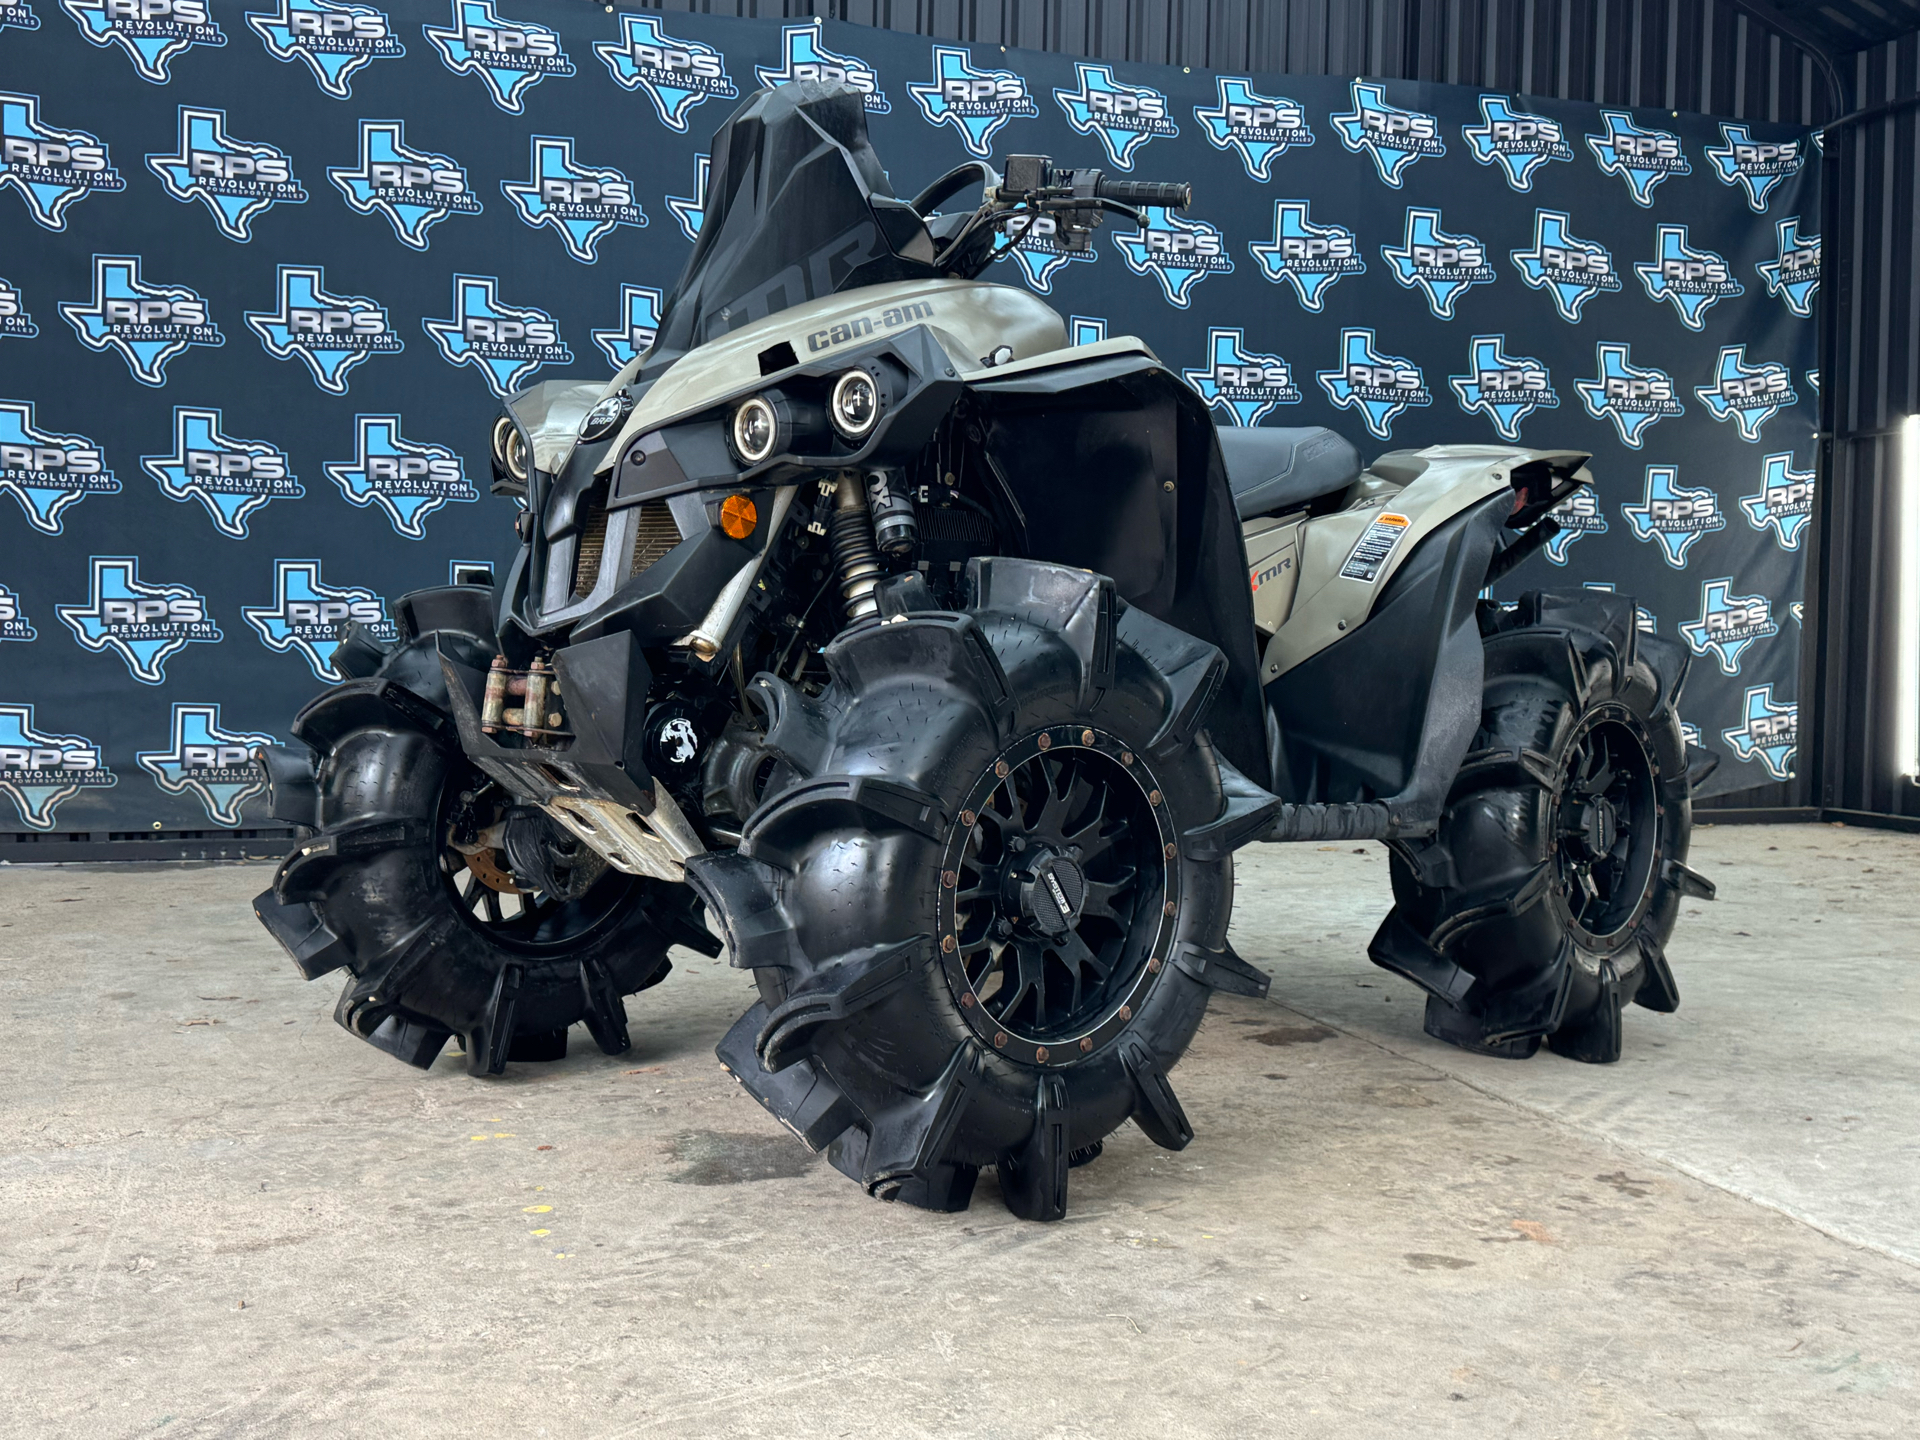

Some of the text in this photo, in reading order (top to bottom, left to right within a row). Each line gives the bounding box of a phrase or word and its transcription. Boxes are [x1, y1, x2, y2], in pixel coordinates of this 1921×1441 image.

[107, 0, 206, 24] RPS
[116, 20, 214, 35] REVOLUTION
[291, 13, 385, 38] RPS
[124, 29, 222, 42] POWERSPORTS SALES
[299, 36, 393, 49] REVOLUTION
[467, 28, 557, 56] RPS
[375, 48, 401, 56] SALES
[474, 51, 564, 67] REVOLUTION
[481, 60, 572, 74] POWERSPORTS SALES
[634, 45, 721, 78] RPS
[641, 68, 727, 89] REVOLUTION
[648, 77, 734, 96] POWERSPORTS SALES
[945, 80, 1022, 102] RPS
[950, 100, 1028, 110] REVOLUTION
[1089, 92, 1164, 119] RPS
[1094, 113, 1169, 129] REVOLUTION
[1228, 106, 1301, 129] RPS
[1363, 110, 1433, 139] RPS
[1233, 127, 1305, 138] REVOLUTION
[1367, 131, 1438, 150] REVOLUTION
[1493, 122, 1559, 141] RPS
[1497, 141, 1565, 150] REVOLUTION
[1615, 136, 1678, 158] RPS
[1736, 142, 1797, 162] RPS
[5, 139, 105, 171] RPS
[1620, 155, 1683, 167] REVOLUTION
[12, 164, 113, 183] REVOLUTION
[192, 153, 288, 183] RPS
[1740, 160, 1798, 170] REVOLUTION
[20, 173, 121, 191] POWERSPORTS SALES
[199, 177, 295, 194] REVOLUTION
[372, 164, 463, 193] RPS
[206, 186, 303, 201] POWERSPORTS SALES
[379, 188, 470, 204] REVOLUTION
[544, 180, 631, 205] RPS
[386, 197, 478, 211] POWERSPORTS SALES
[550, 203, 637, 216] REVOLUTION
[1147, 232, 1220, 256] RPS
[1282, 239, 1352, 259] RPS
[1152, 253, 1225, 265] REVOLUTION
[1287, 259, 1357, 267] REVOLUTION
[1414, 248, 1482, 268] RPS
[1542, 248, 1609, 274] RPS
[1418, 267, 1487, 276] REVOLUTION
[1547, 268, 1613, 284] REVOLUTION
[1664, 261, 1727, 282] RPS
[1669, 280, 1732, 291] REVOLUTION
[107, 301, 205, 325] RPS
[113, 325, 212, 335] REVOLUTION
[291, 311, 385, 334] RPS
[808, 301, 934, 352] can-am
[297, 334, 391, 344] REVOLUTION
[466, 319, 556, 345] RPS
[473, 342, 562, 356] REVOLUTION
[545, 354, 569, 362] SALES
[1217, 367, 1288, 387] RPS
[1349, 366, 1419, 389] RPS
[1480, 371, 1546, 390] RPS
[1221, 387, 1293, 396] REVOLUTION
[1354, 386, 1424, 399] REVOLUTION
[1484, 390, 1551, 398] REVOLUTION
[1606, 379, 1671, 400] RPS
[1723, 373, 1788, 400] RPS
[1610, 398, 1676, 409] REVOLUTION
[1730, 391, 1793, 406] REVOLUTION
[590, 417, 613, 425] BRP
[0, 446, 101, 474] RPS
[188, 452, 285, 479] RPS
[8, 470, 108, 485] REVOLUTION
[368, 458, 460, 482] RPS
[16, 479, 117, 492] POWERSPORTS SALES
[195, 476, 292, 490] REVOLUTION
[273, 488, 300, 496] SALES
[375, 481, 467, 492] REVOLUTION
[1651, 500, 1714, 520] RPS
[1655, 518, 1718, 527] REVOLUTION
[104, 600, 202, 624] RPS
[288, 602, 381, 624] RPS
[1706, 605, 1767, 632] RPS
[111, 623, 210, 633] REVOLUTION
[1710, 622, 1769, 639] REVOLUTION
[0, 749, 97, 770] RPS
[4, 770, 104, 780] REVOLUTION
